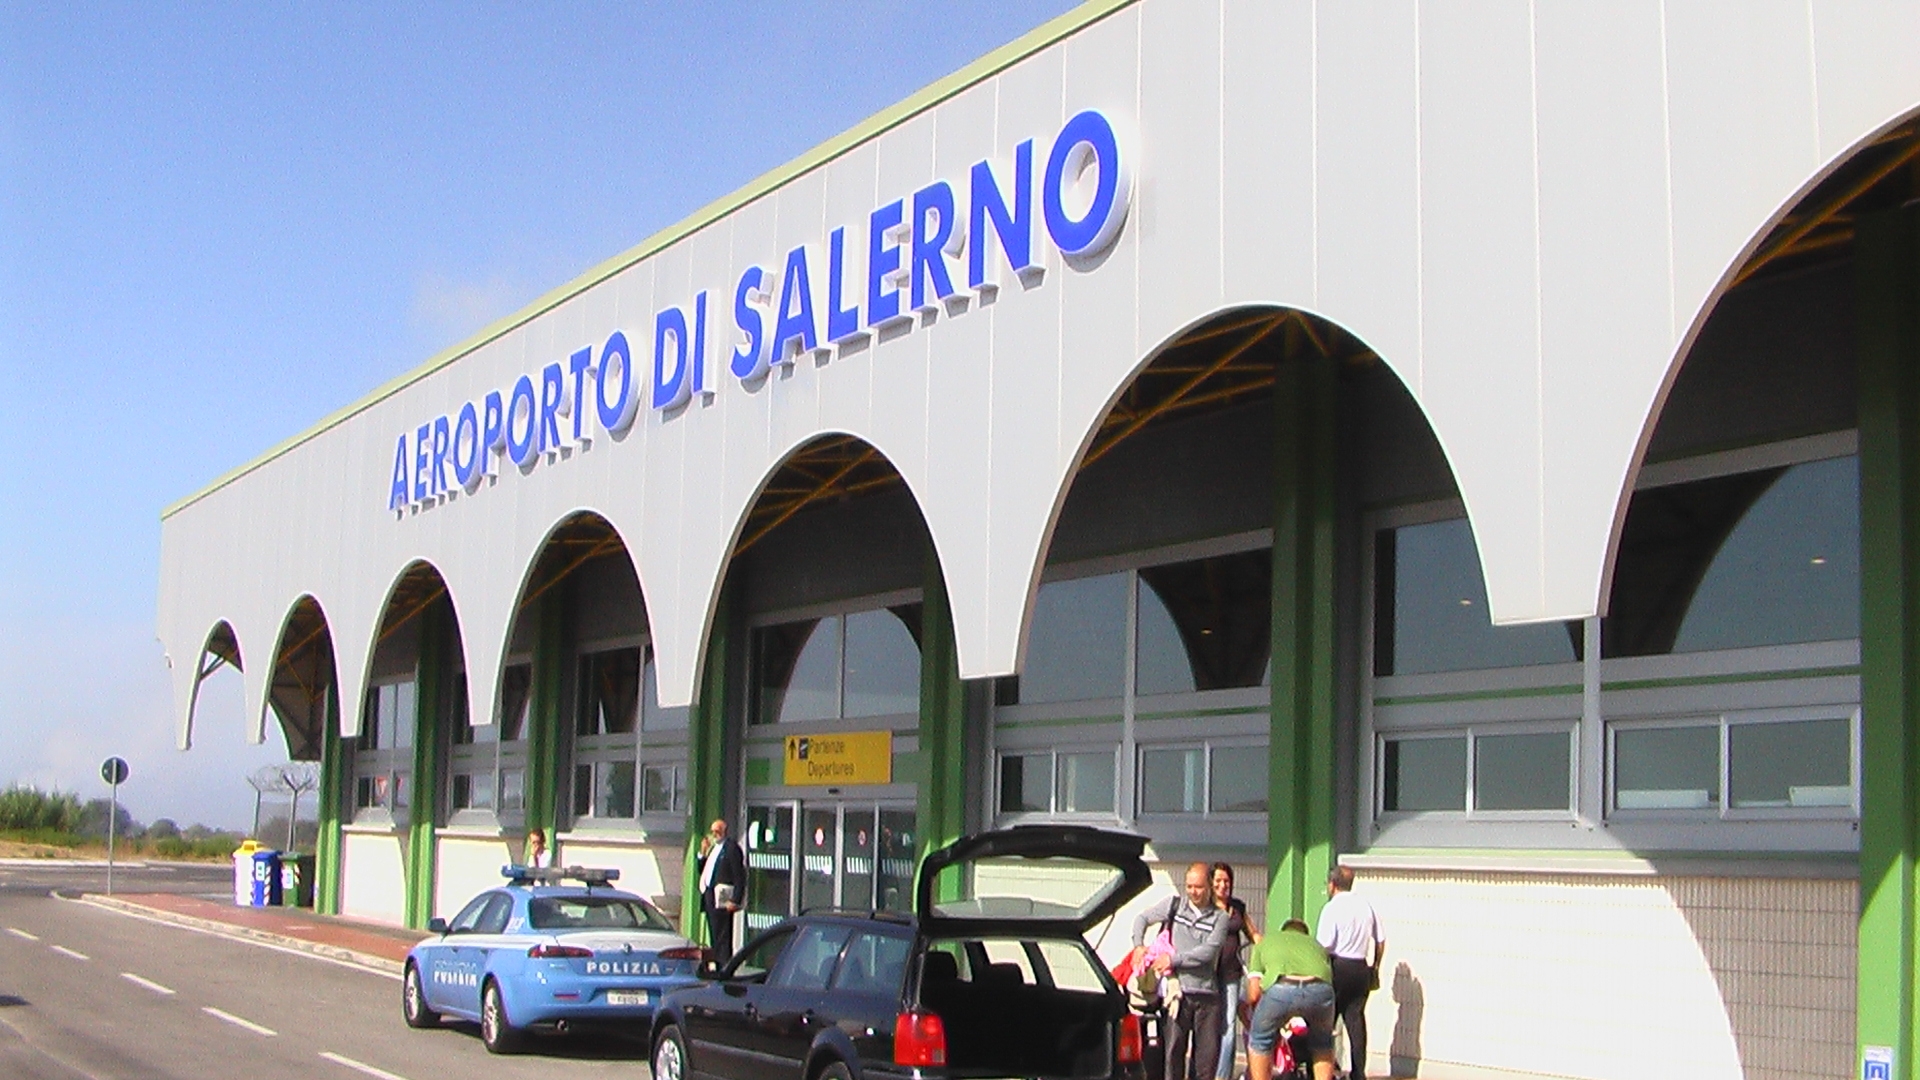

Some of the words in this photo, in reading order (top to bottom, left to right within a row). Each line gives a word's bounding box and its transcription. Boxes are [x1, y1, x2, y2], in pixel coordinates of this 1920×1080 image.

[389, 332, 633, 510] AEROPORTO
[652, 290, 709, 409] DI
[730, 110, 1121, 380] SALERNO
[809, 738, 846, 754] Partenze
[808, 761, 855, 778] Departures
[586, 961, 660, 974] POLIZIA
